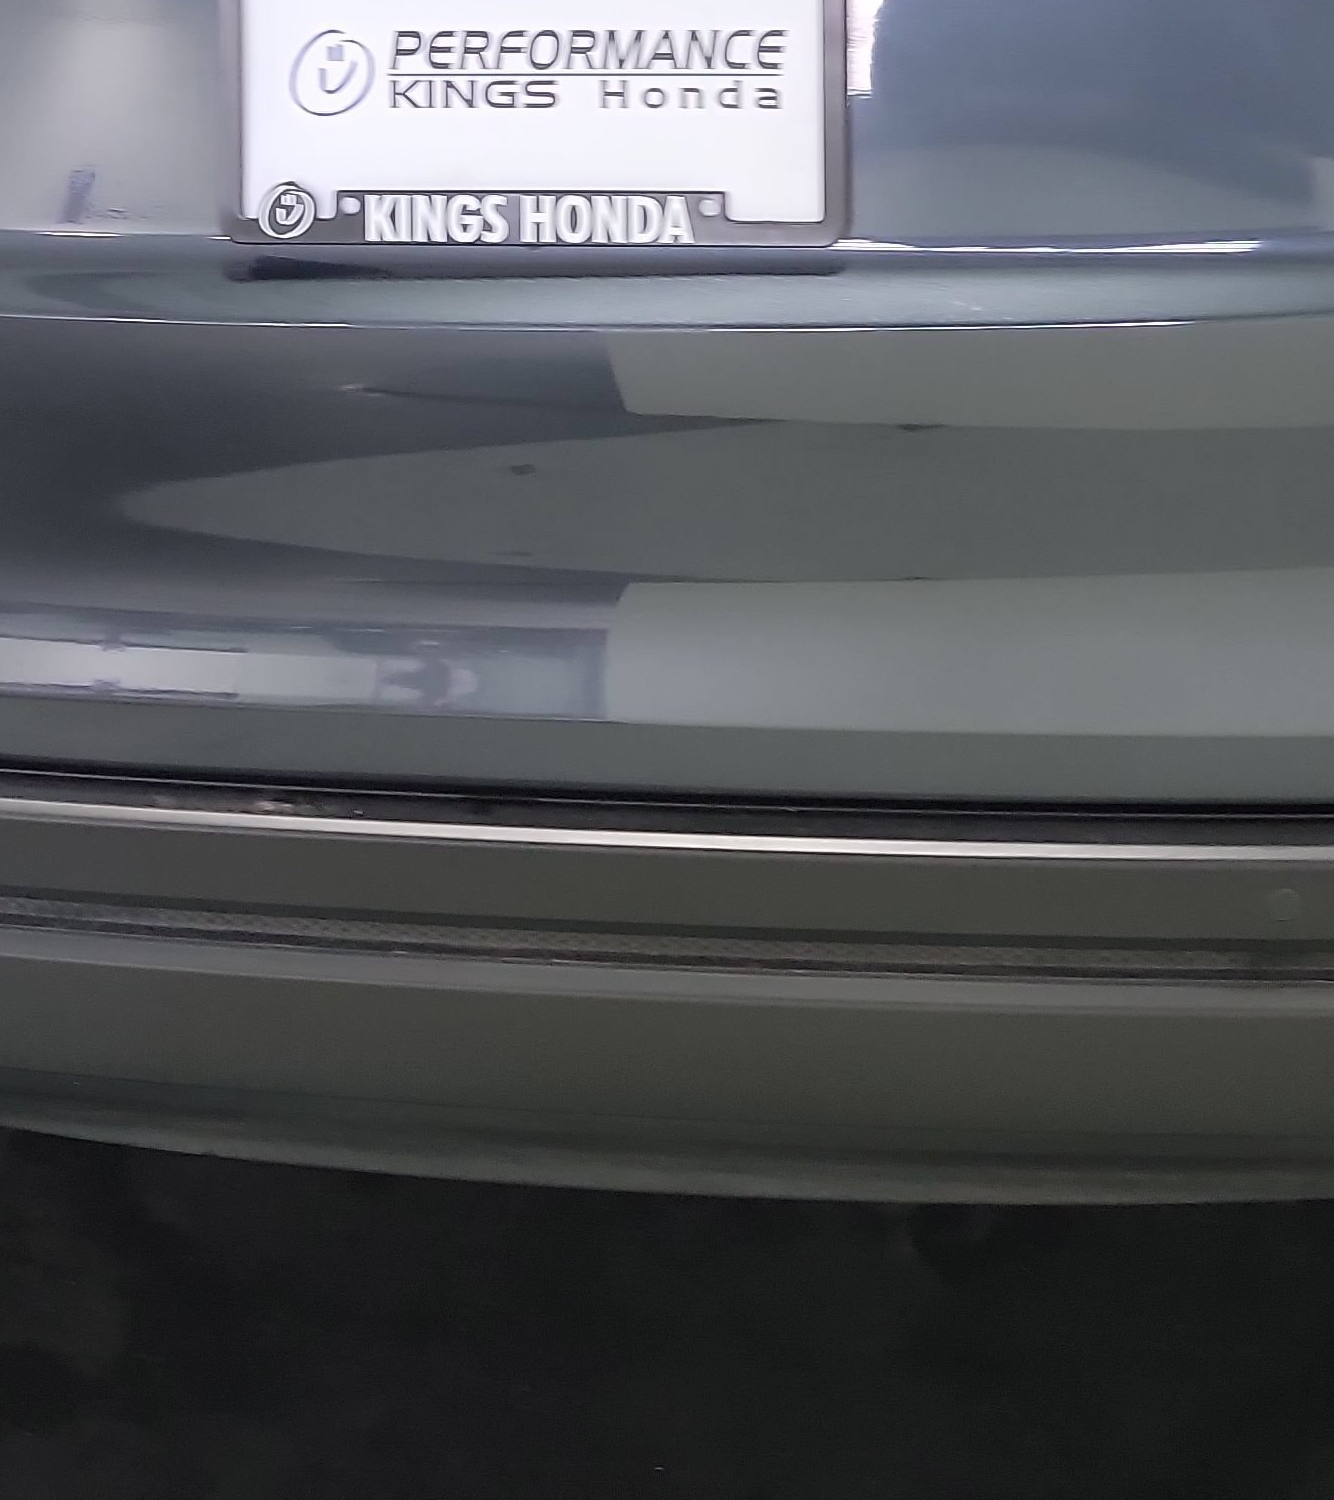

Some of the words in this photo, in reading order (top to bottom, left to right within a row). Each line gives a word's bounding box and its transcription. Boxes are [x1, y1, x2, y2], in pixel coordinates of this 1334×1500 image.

[389, 30, 787, 71] PERFORMANCE
[388, 80, 559, 110] KINGS
[600, 80, 784, 110] Honda
[364, 193, 510, 246] KINGS
[520, 194, 696, 245] HONDA
